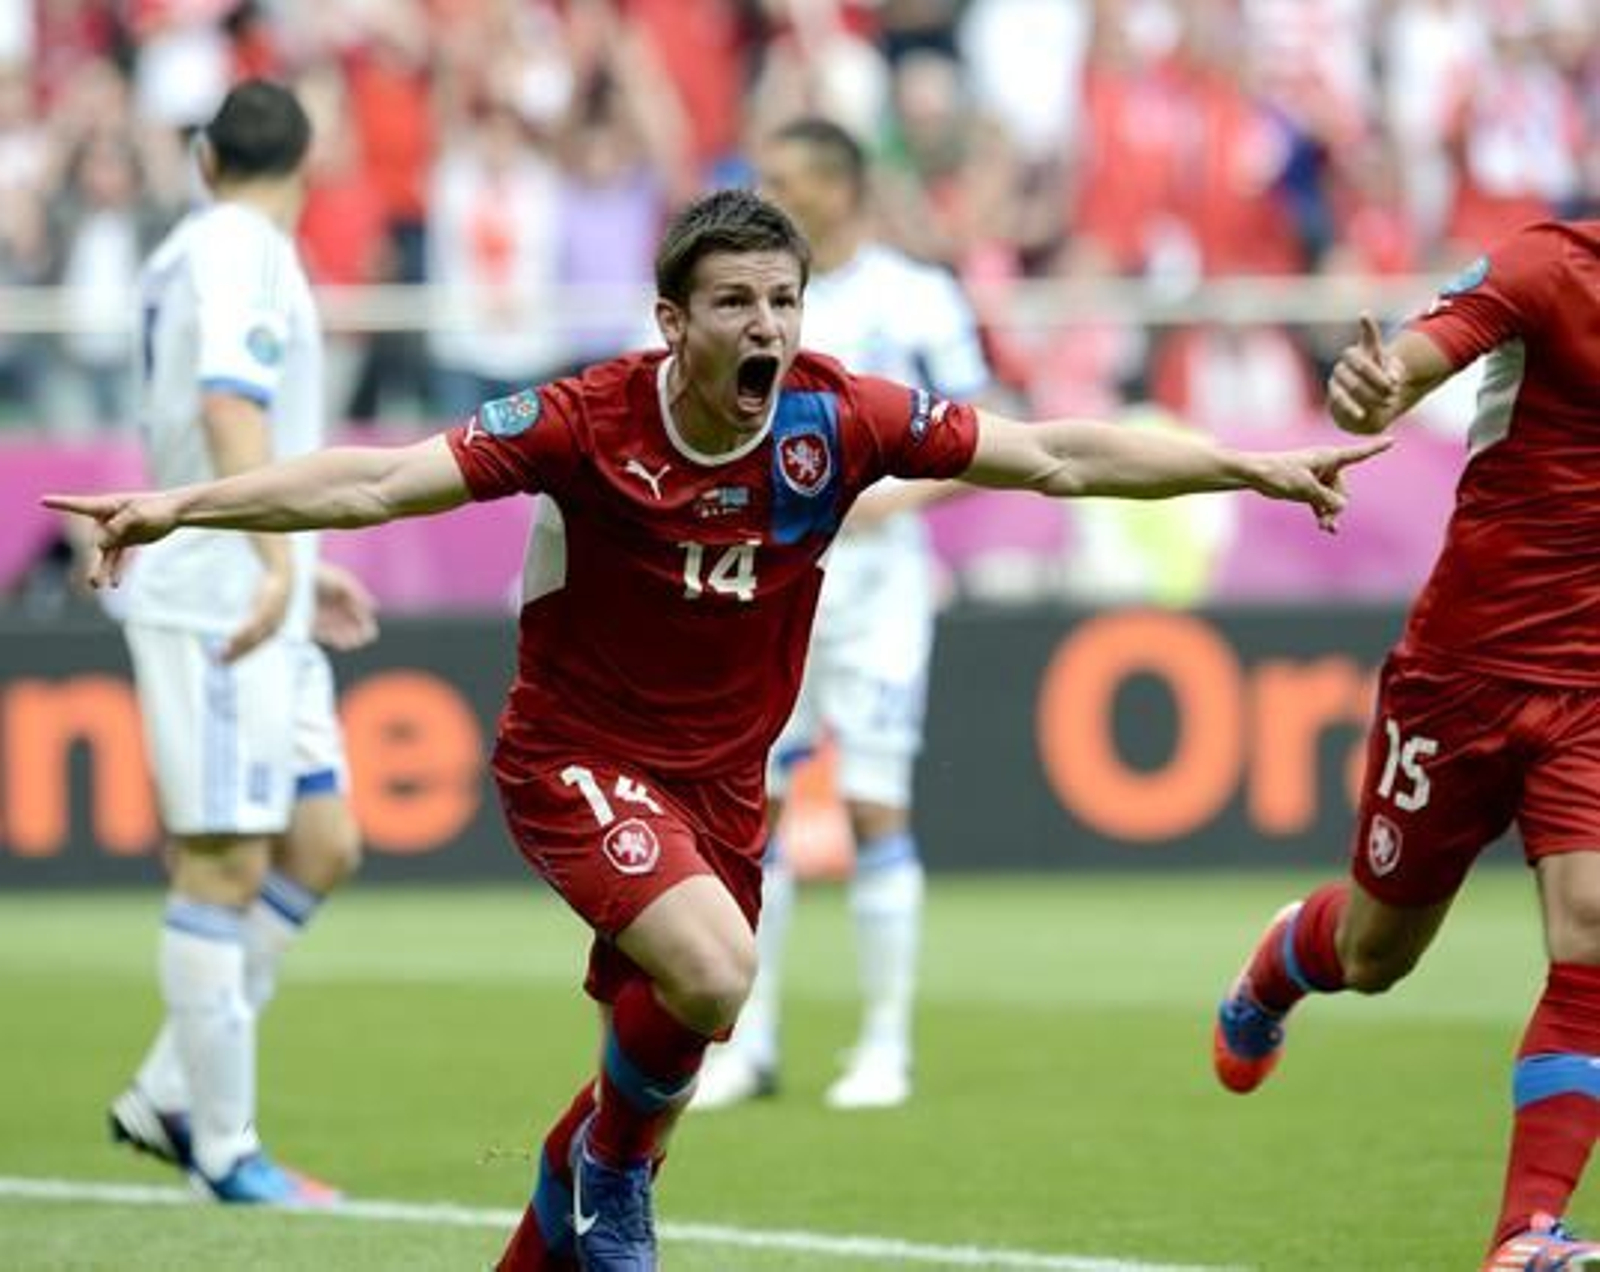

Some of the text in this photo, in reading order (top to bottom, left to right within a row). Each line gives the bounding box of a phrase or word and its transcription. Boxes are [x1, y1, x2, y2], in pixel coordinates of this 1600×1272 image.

[678, 539, 762, 600] 14
[1036, 608, 1378, 842] Or
[559, 765, 664, 827] 14
[1378, 718, 1438, 812] 15
